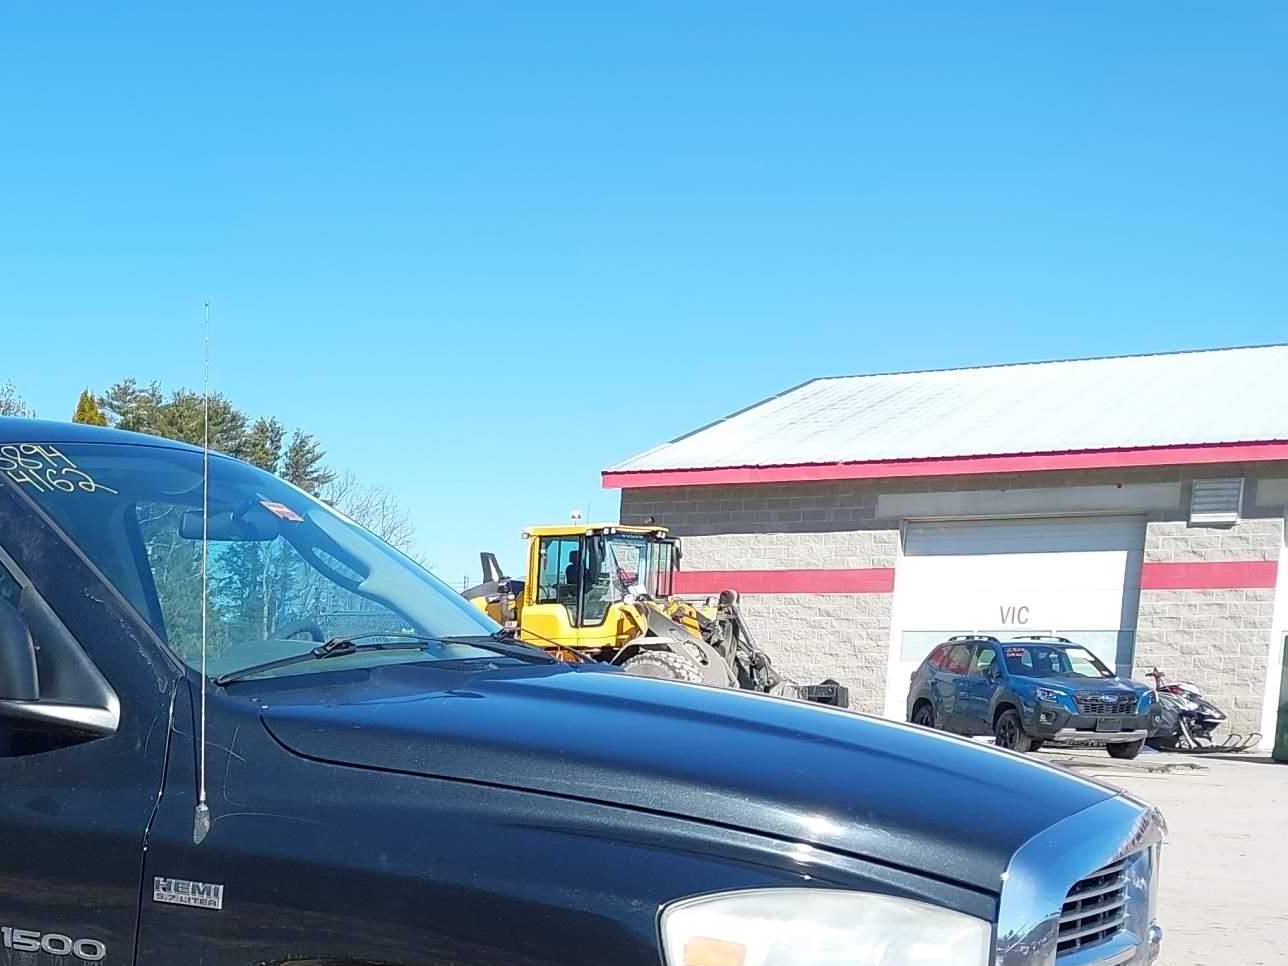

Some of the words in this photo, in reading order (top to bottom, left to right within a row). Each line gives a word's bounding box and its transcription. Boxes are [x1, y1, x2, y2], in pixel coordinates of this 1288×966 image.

[6, 468, 118, 494] 4162
[999, 605, 1030, 625] VIC
[154, 878, 220, 898] HEMI
[1, 926, 107, 961] 1500
